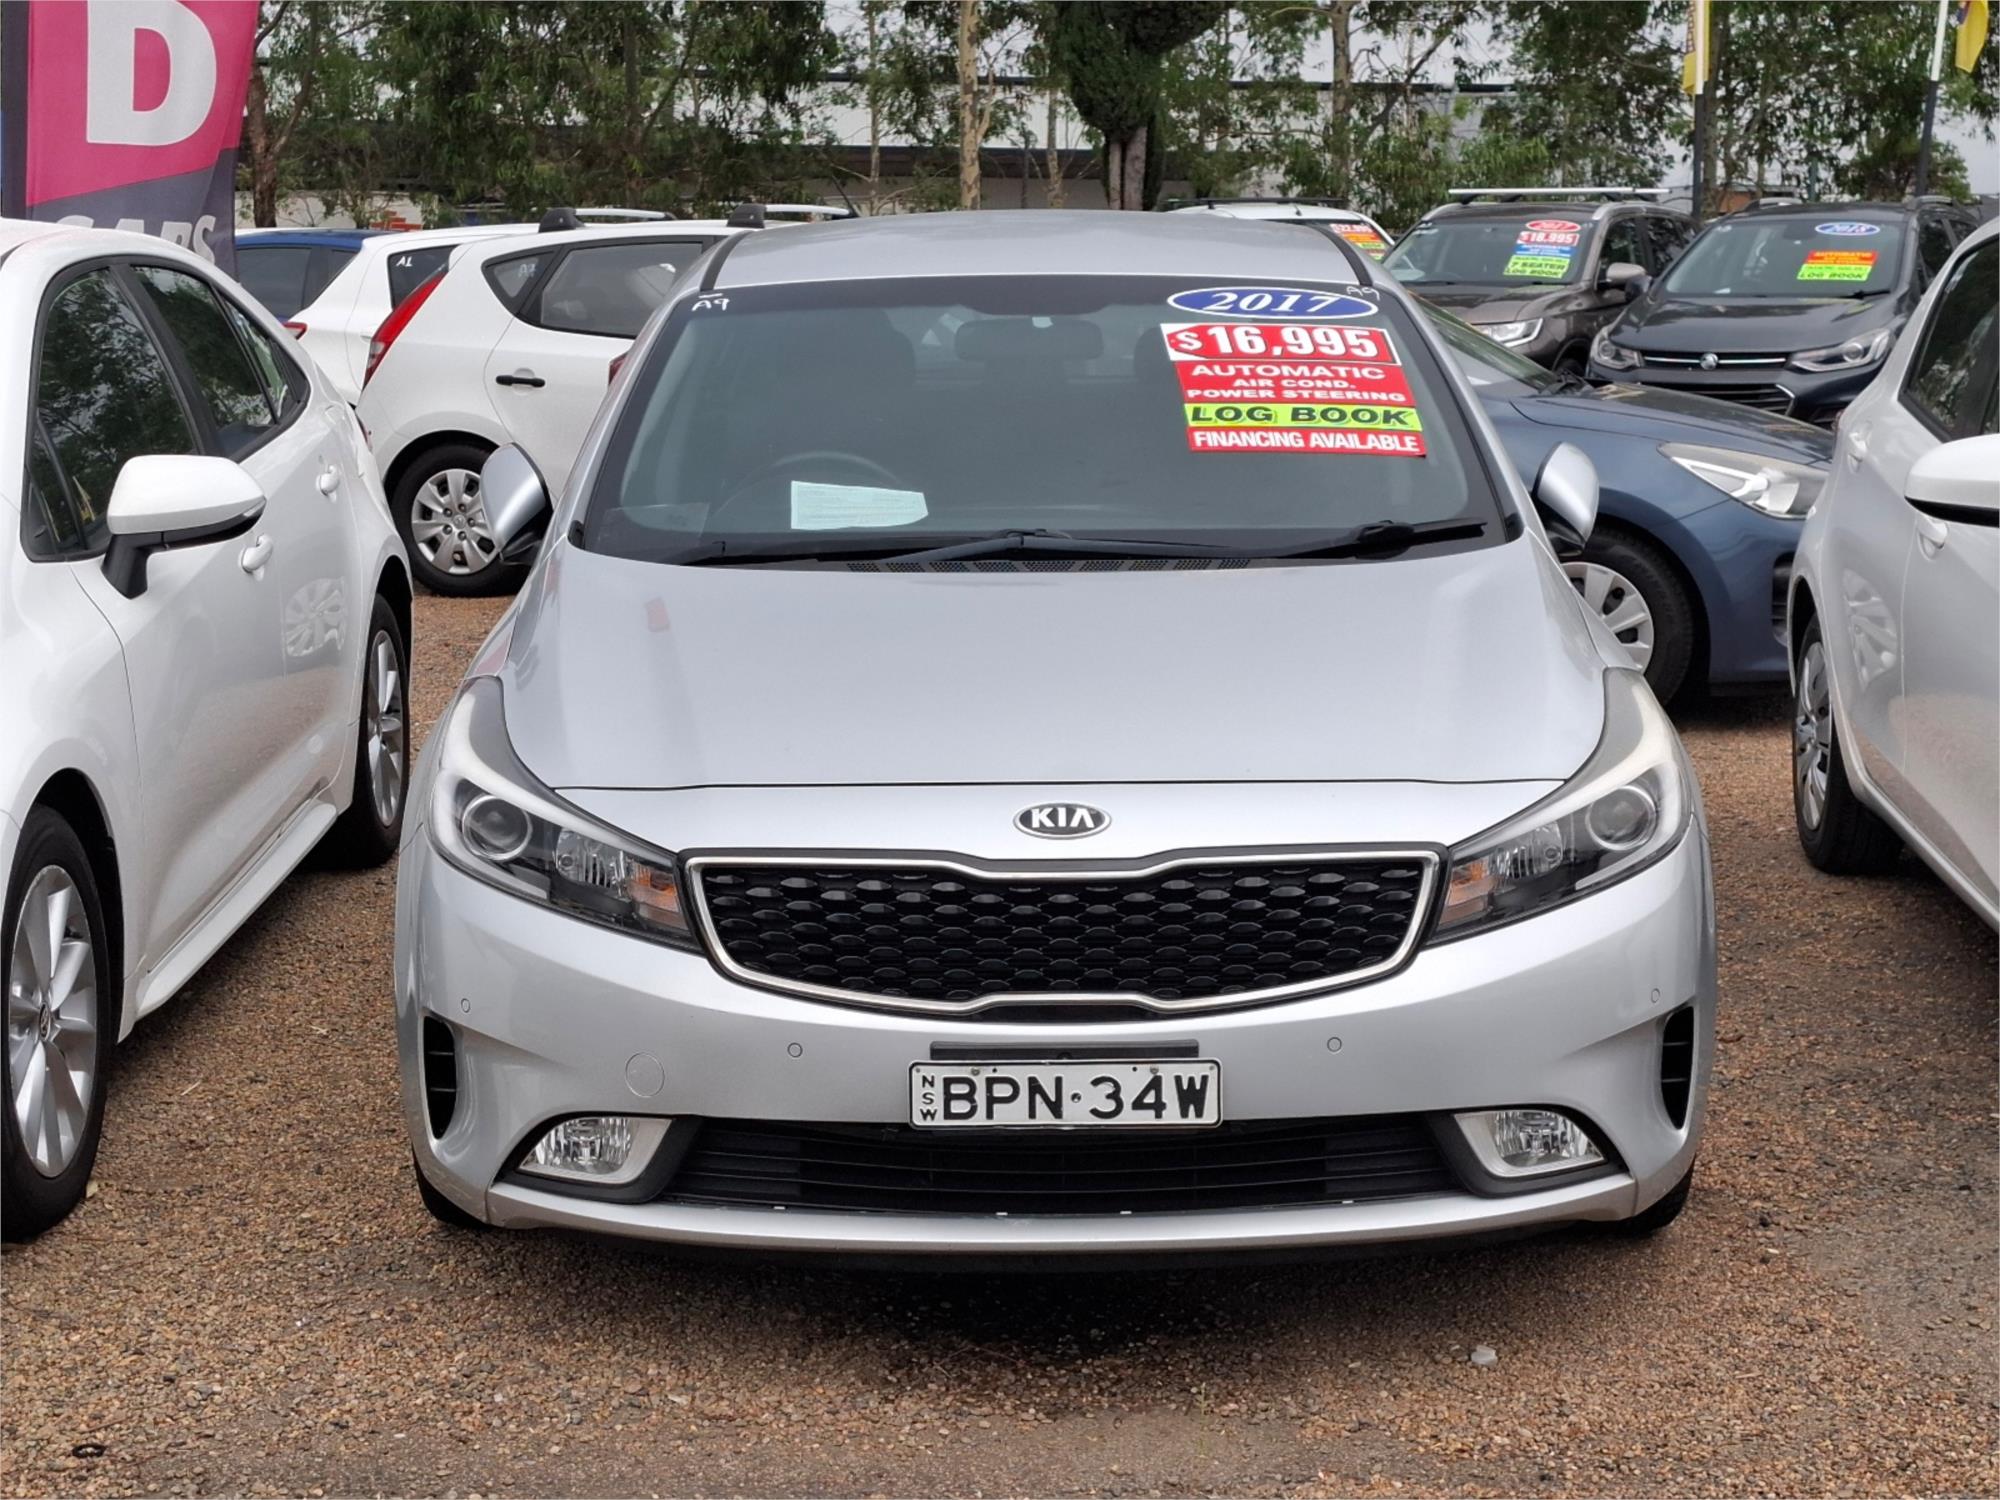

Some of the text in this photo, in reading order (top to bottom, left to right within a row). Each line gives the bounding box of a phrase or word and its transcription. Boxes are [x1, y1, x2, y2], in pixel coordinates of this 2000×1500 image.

[1202, 292, 1342, 312] 2017
[1191, 364, 1386, 380] AUTOMATIC
[1231, 379, 1355, 389] AIR COND.
[1186, 389, 1407, 402] POWER STEERING
[1191, 405, 1412, 427] LOG BOOK
[1193, 431, 1421, 451] FINANCING AVAILABLE
[1030, 806, 1095, 829] KIA
